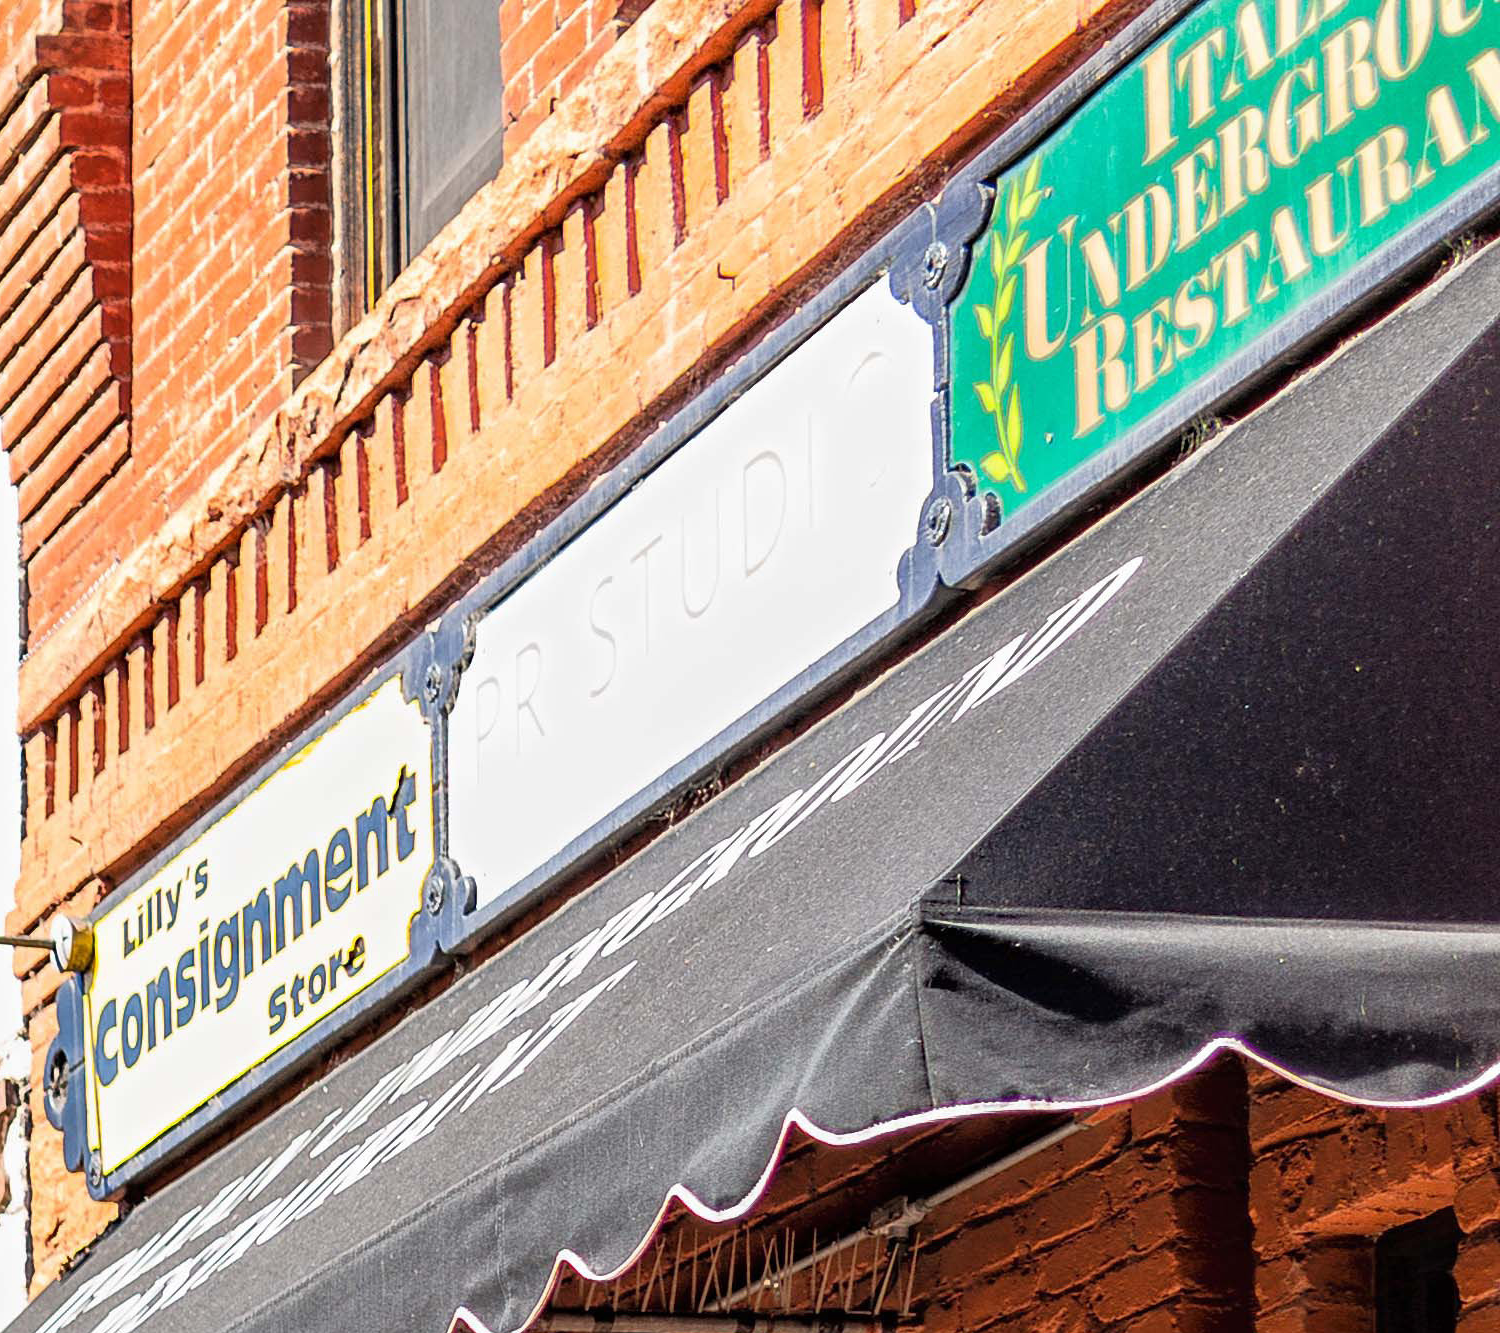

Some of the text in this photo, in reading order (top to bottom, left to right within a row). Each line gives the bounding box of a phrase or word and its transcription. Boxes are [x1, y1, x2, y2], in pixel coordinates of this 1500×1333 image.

[1141, 0, 1348, 167] ITAL
[1020, 0, 1487, 361] UNDERGRO
[1072, 48, 1500, 440] RESTAURAN
[122, 858, 209, 958] Lilly's
[267, 934, 366, 1036] Store
